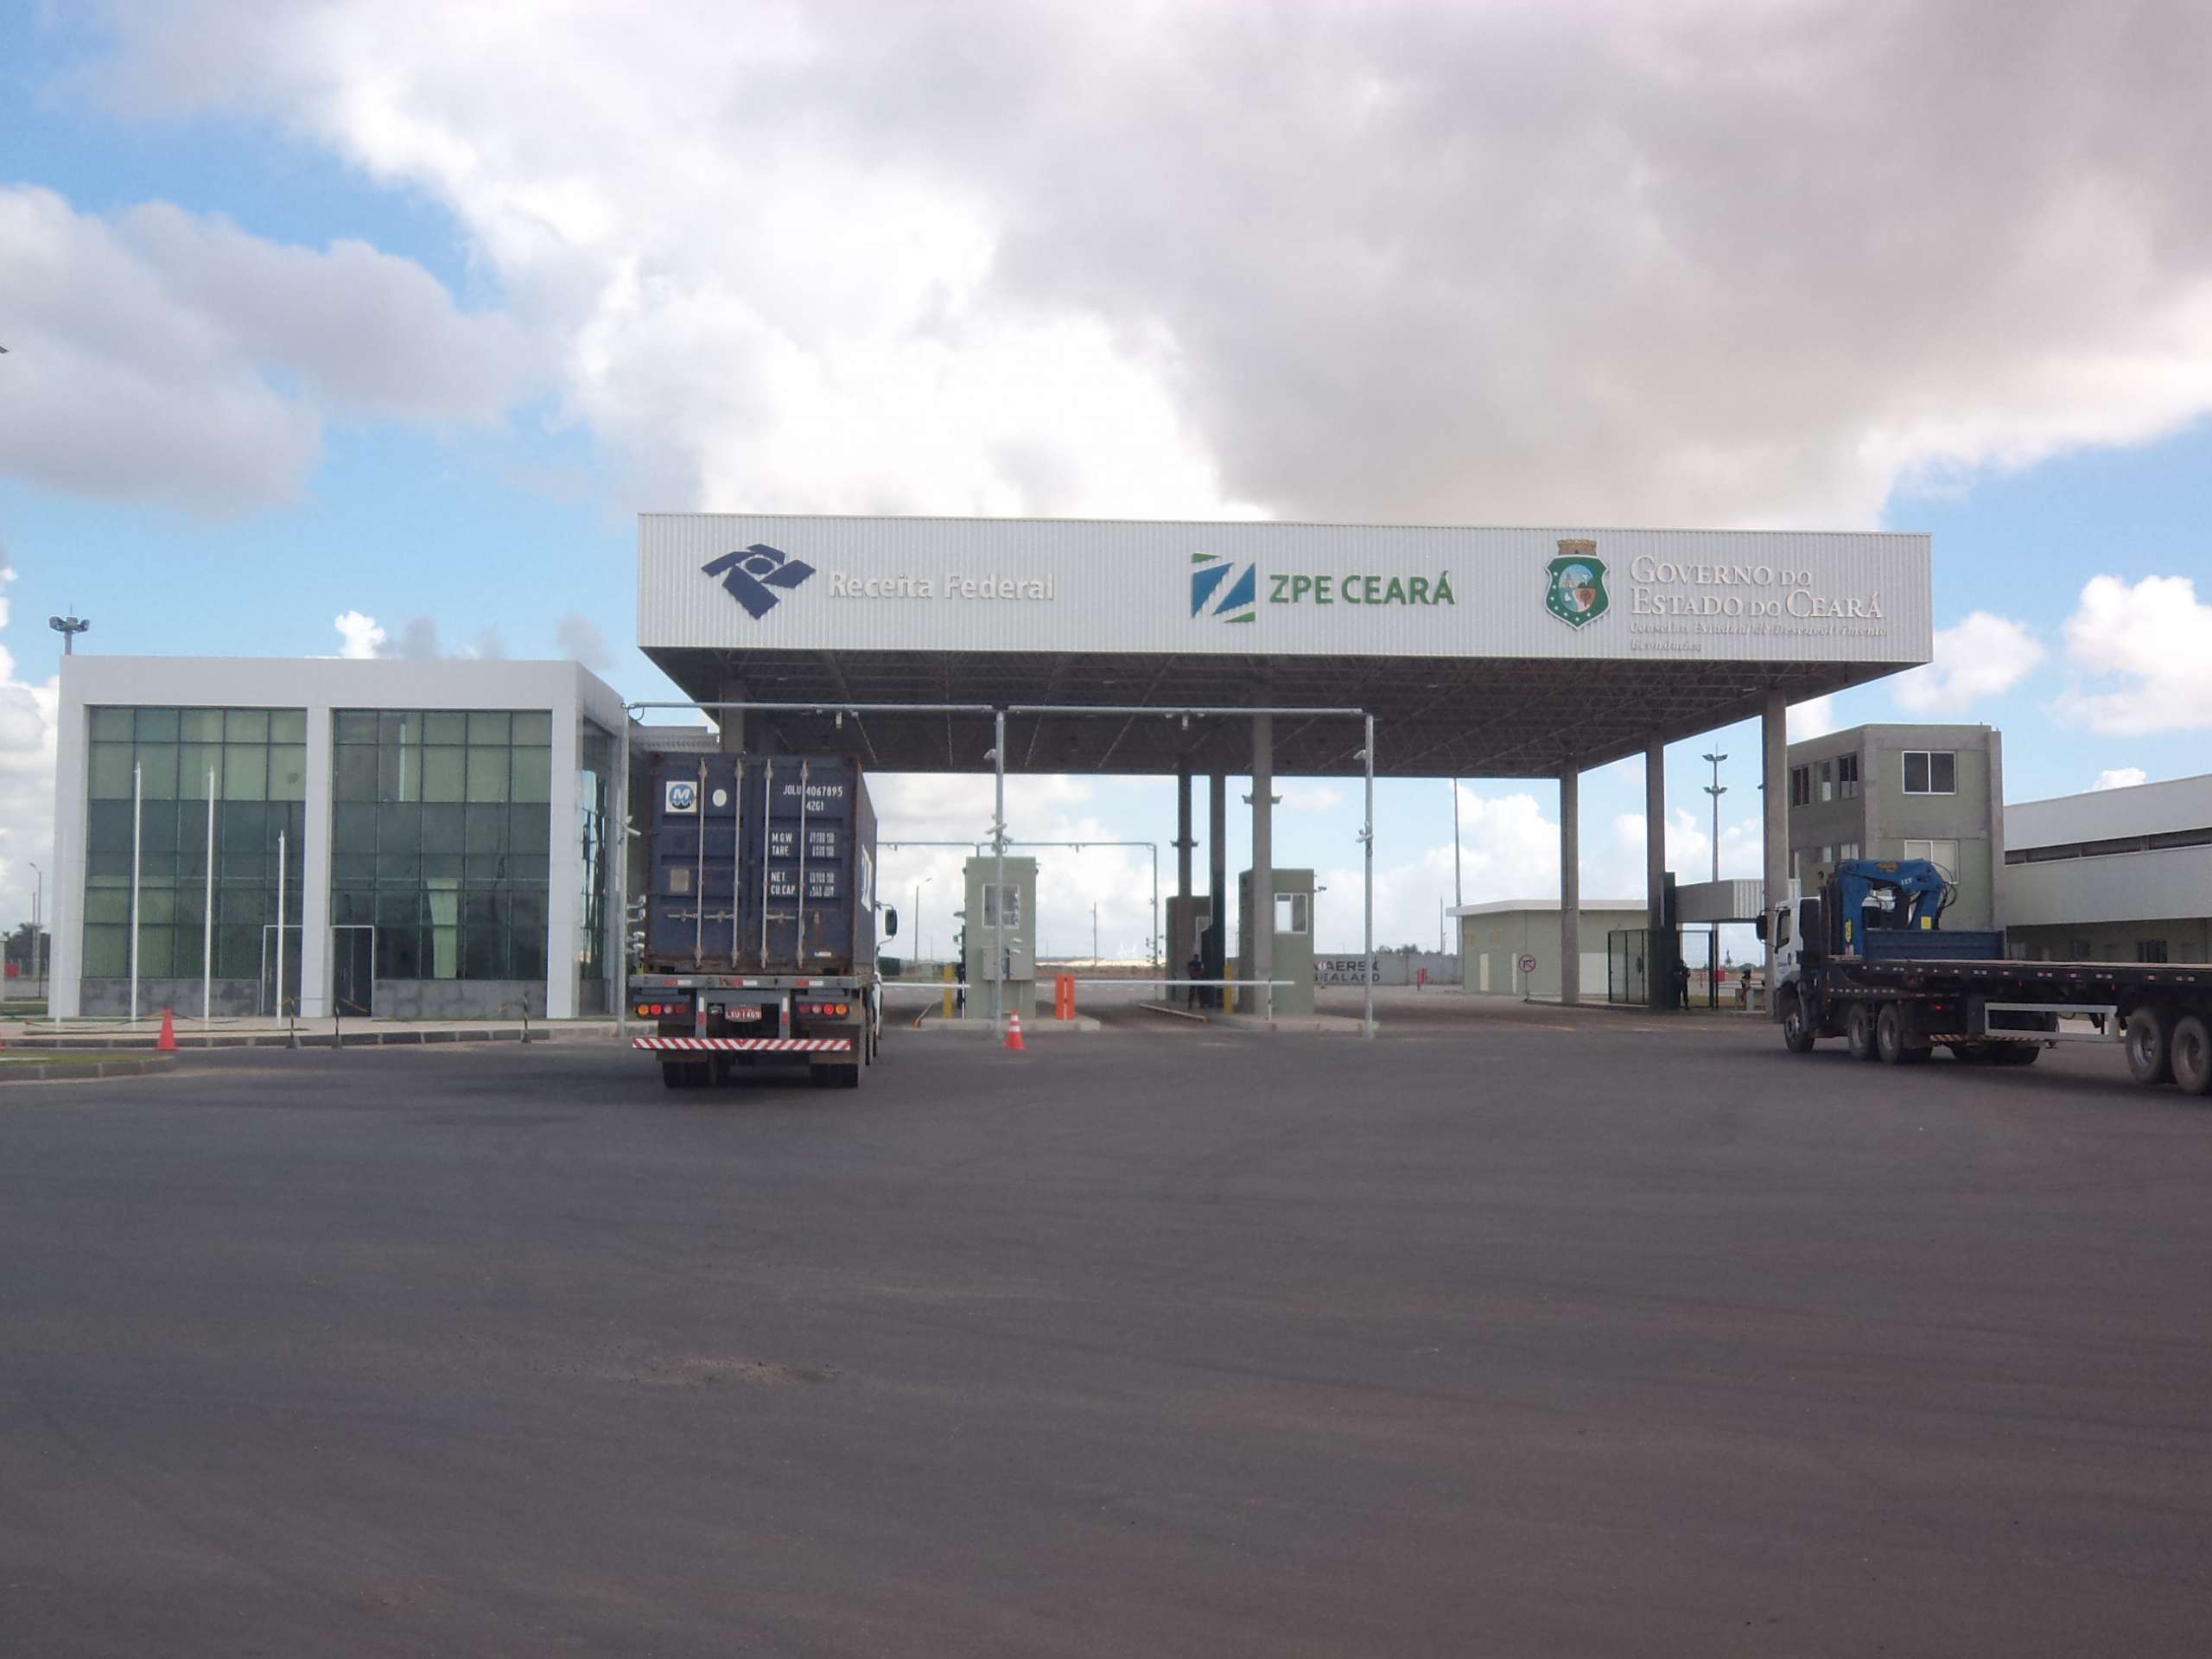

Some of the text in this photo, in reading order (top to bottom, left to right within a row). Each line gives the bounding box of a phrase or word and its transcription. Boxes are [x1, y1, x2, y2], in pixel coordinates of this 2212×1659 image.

[1630, 555, 1812, 586] GOVERNO DO
[830, 573, 1054, 601] Receita Federal
[1269, 570, 1455, 605] ZPE CEARÁ
[1630, 587, 1885, 619] ESTADO DO CEARÁ
[783, 785, 843, 797] JOLU 4067895
